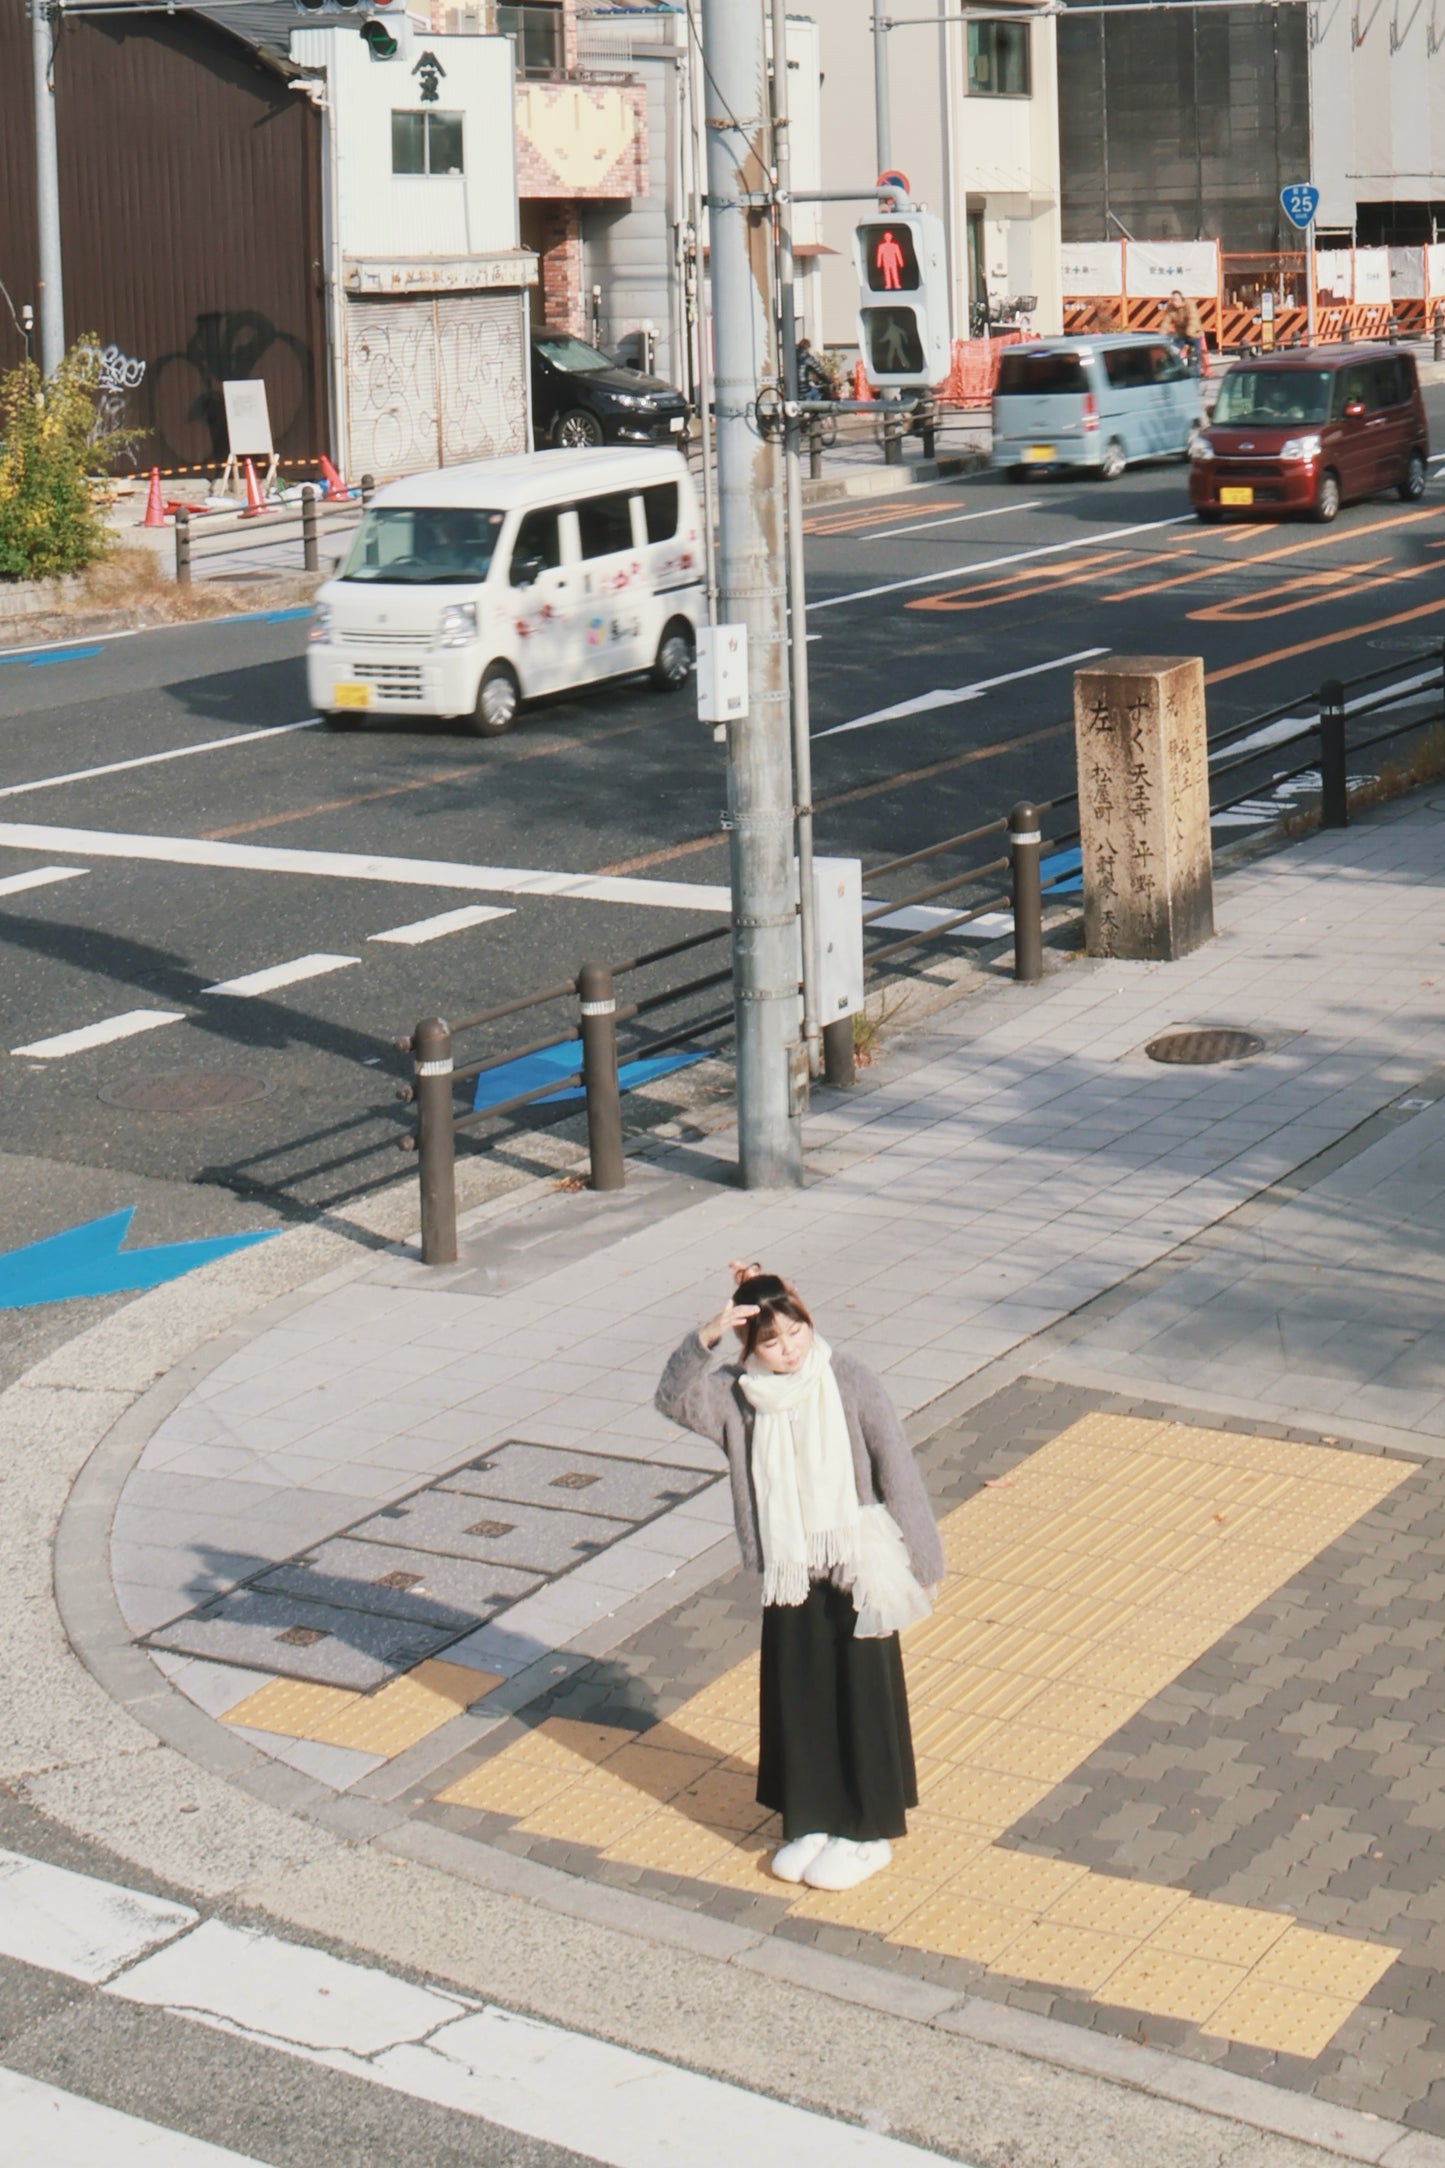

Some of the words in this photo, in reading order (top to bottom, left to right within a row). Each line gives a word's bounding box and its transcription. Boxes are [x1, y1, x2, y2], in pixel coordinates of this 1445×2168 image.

[1290, 196, 1313, 213] 25
[1088, 700, 1114, 734] 左
[1089, 762, 1114, 826] 松屋町
[1127, 763, 1153, 826] 天王寺
[1132, 840, 1156, 900] 平野
